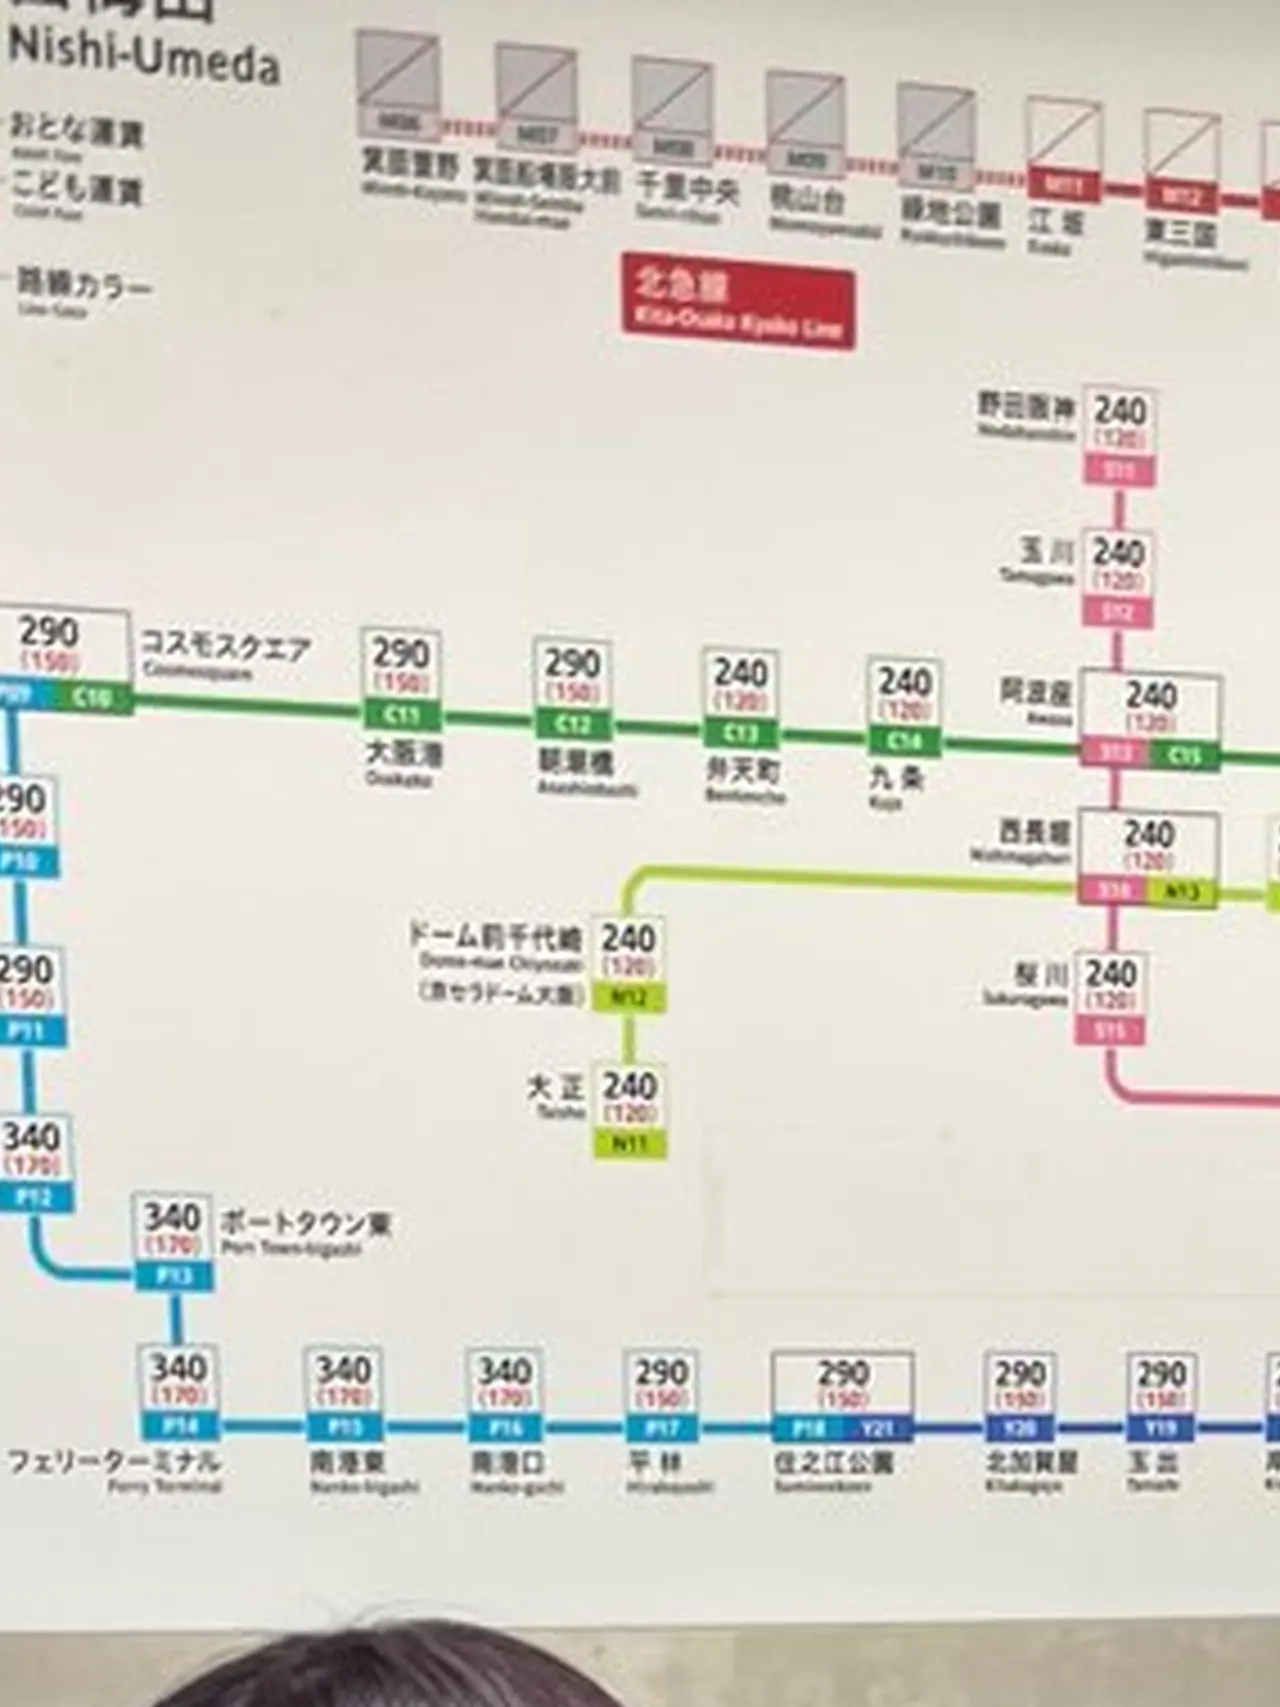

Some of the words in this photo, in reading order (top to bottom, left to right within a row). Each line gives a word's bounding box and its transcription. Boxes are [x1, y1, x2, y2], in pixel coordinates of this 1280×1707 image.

[10, 24, 280, 87] Nishi-Umeda
[1093, 395, 1146, 425] 240
[1093, 539, 1145, 568] 240
[20, 616, 80, 648] 290
[142, 628, 312, 663] コスモスクエア
[373, 637, 430, 669] 290
[544, 648, 601, 680] 290
[714, 658, 768, 688] 240
[877, 667, 931, 696] 240
[1126, 681, 1177, 710] 240
[1123, 820, 1175, 849] 240
[601, 923, 656, 952] 240
[1085, 960, 1137, 989] 240
[602, 1073, 658, 1101] 240
[2, 1123, 61, 1152] 340
[144, 1202, 201, 1232] 340
[151, 1353, 207, 1383] 340
[316, 1355, 372, 1384] 340
[478, 1356, 532, 1387] 340
[635, 1358, 689, 1387] 290
[818, 1360, 870, 1387] 290
[995, 1360, 1046, 1388] 290
[1138, 1360, 1188, 1388] 290
